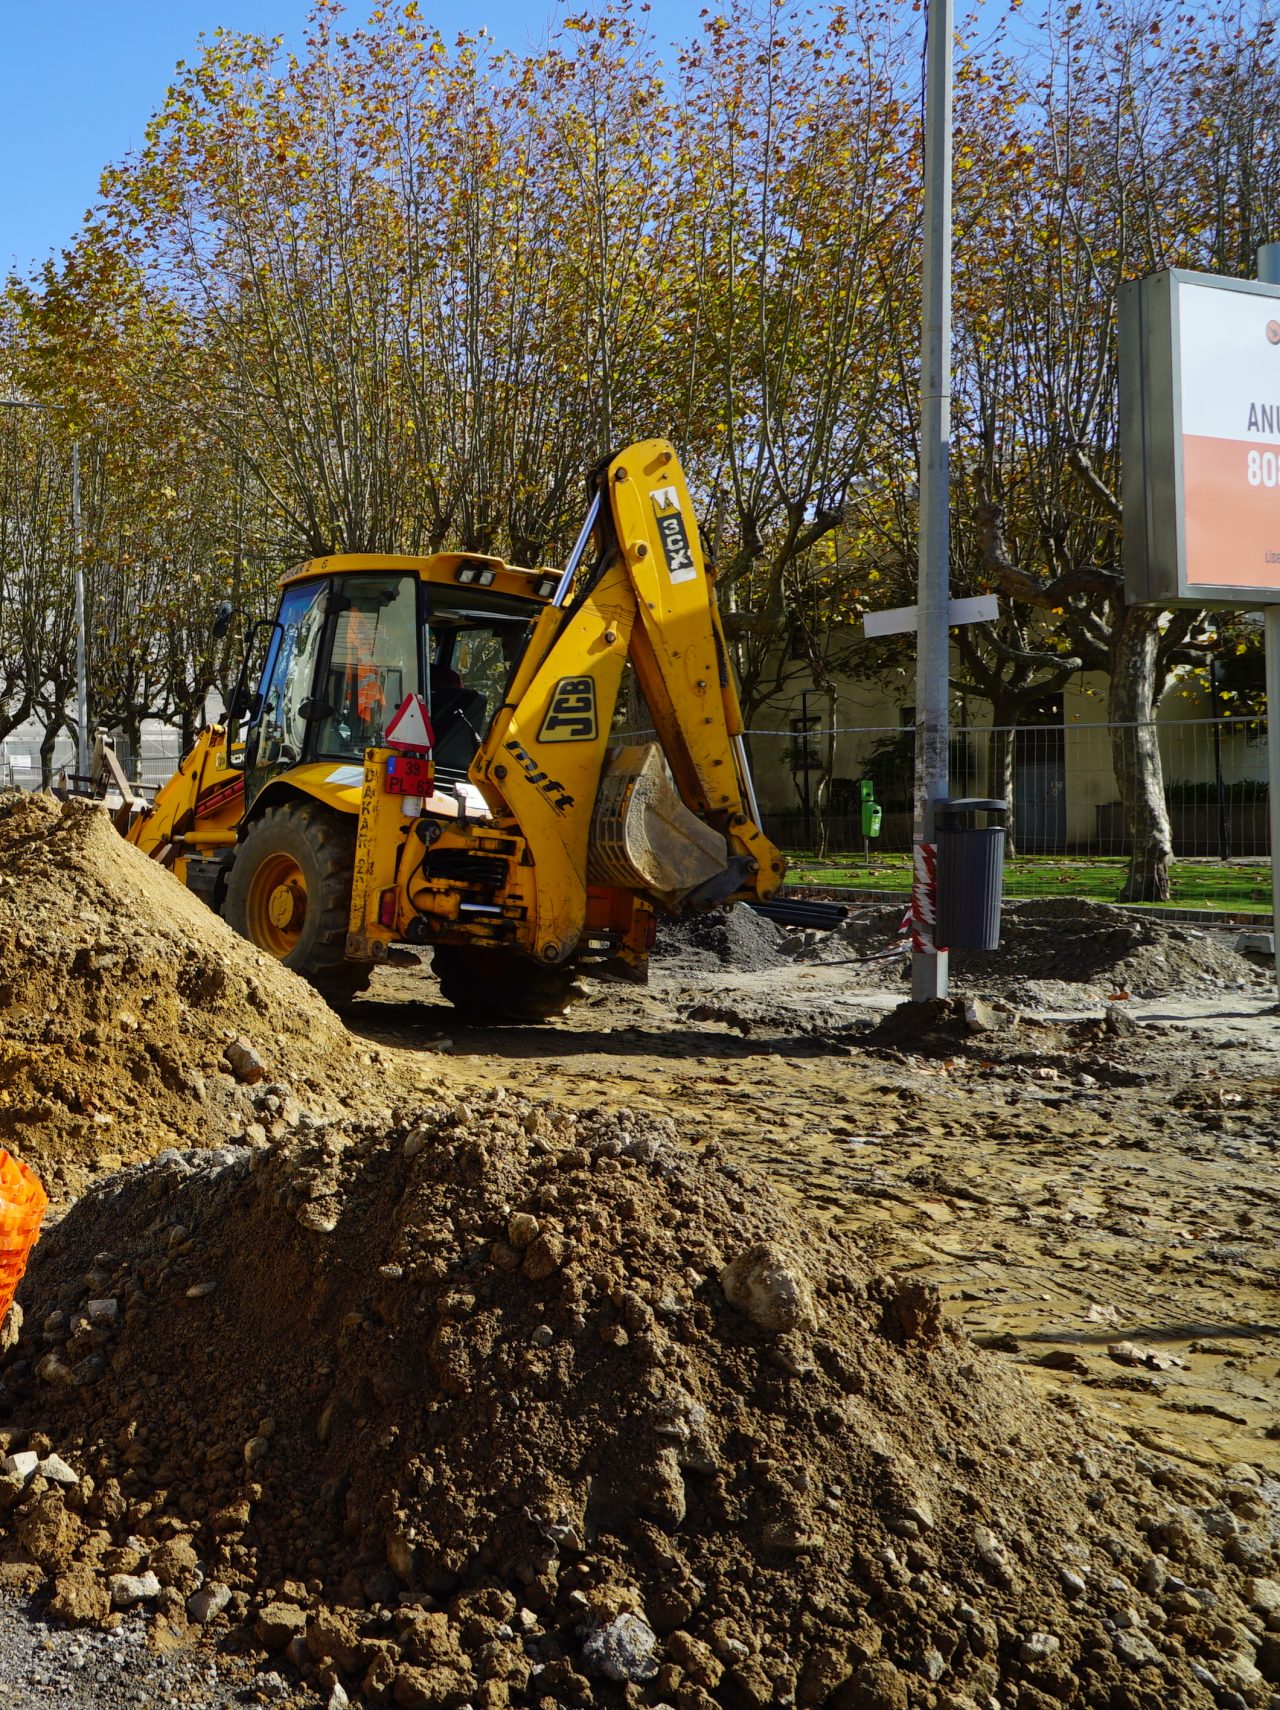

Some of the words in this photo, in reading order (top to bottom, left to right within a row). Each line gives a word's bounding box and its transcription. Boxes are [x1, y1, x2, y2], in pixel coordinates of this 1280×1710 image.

[1247, 402, 1280, 434] AN
[1248, 450, 1280, 487] 80
[662, 518, 689, 570] 3CX
[545, 679, 593, 736] JCB
[390, 776, 407, 792] PL
[417, 780, 432, 795] 62
[405, 761, 420, 776] 39
